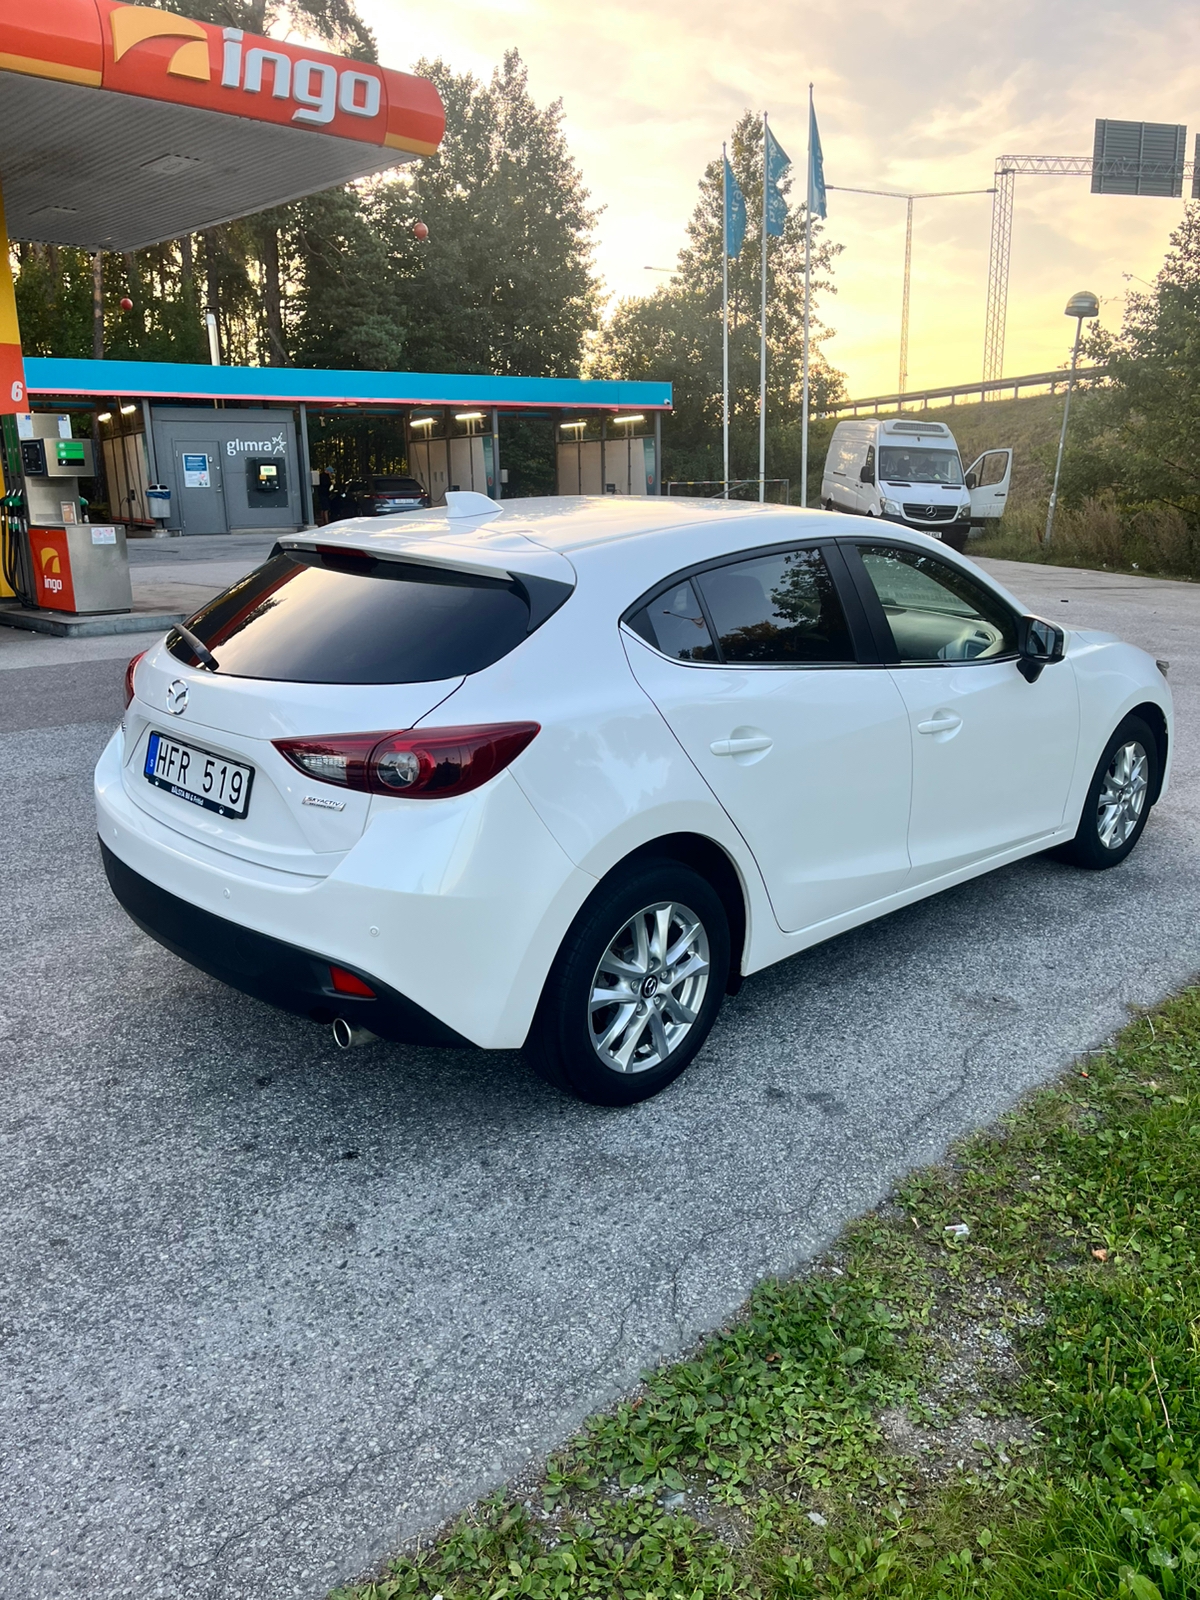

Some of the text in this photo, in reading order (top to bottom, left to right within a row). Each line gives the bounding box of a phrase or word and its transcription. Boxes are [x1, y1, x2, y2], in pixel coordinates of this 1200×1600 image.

[221, 27, 381, 126] ingo
[11, 381, 23, 402] 6
[226, 438, 272, 456] glimra
[43, 574, 62, 593] ingo
[155, 741, 243, 805] HFR 519
